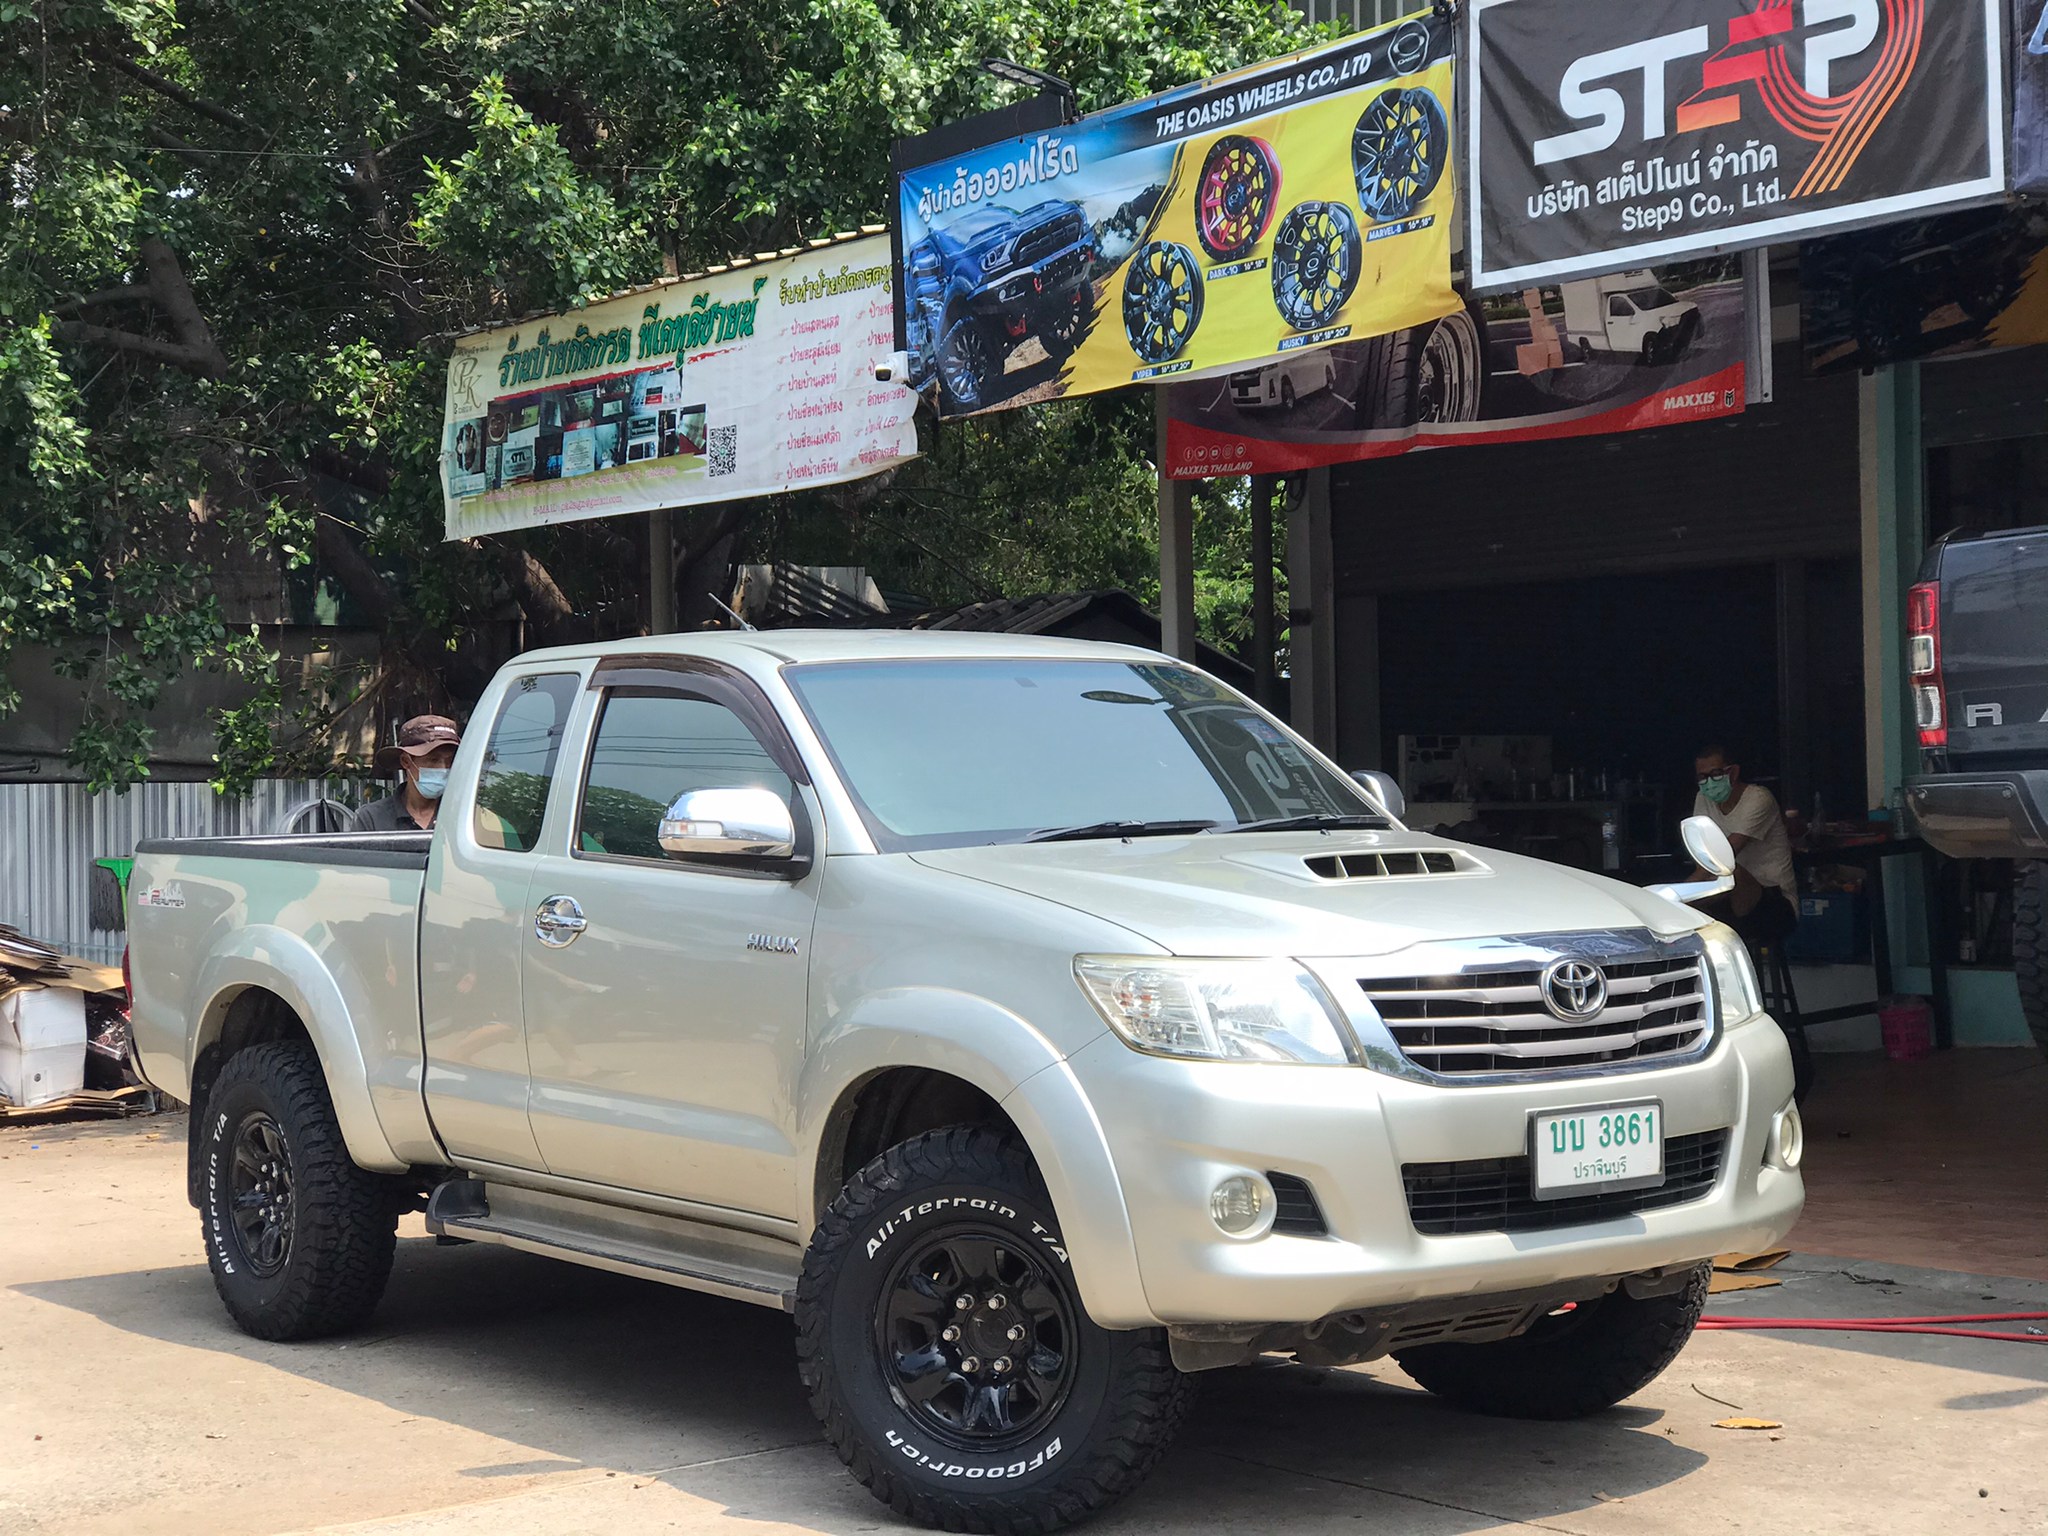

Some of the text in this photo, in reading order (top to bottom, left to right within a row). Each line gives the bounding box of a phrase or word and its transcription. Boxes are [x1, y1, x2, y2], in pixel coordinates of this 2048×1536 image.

[1156, 111, 1184, 137] THE
[1187, 96, 1235, 129] OASIS
[1237, 73, 1305, 113] WHEELS
[1527, 140, 1778, 218] บริษัท สเต็ปไนน์ จำกัด
[1621, 178, 1787, 231] Step9 Co., Ltd.
[498, 322, 632, 388] ร้านป้ายกัดกรด
[1282, 336, 1305, 349] HUSKY
[1136, 368, 1153, 378] VIPER
[1664, 391, 1715, 410] MAXXIS
[883, 416, 899, 429] LED
[786, 457, 839, 479] ป้ายหน้าบริษัท
[1174, 462, 1253, 476] MAXXIS THAILAND
[747, 933, 800, 955] HILUX
[1551, 1111, 1653, 1153] บบ 3861
[1574, 1156, 1627, 1178] ปราจีนบุรี
[207, 1112, 235, 1275] All-Terrain T/A
[865, 1196, 1068, 1265] All-Terrain T/A
[885, 1429, 1063, 1479] BFGoodrich
